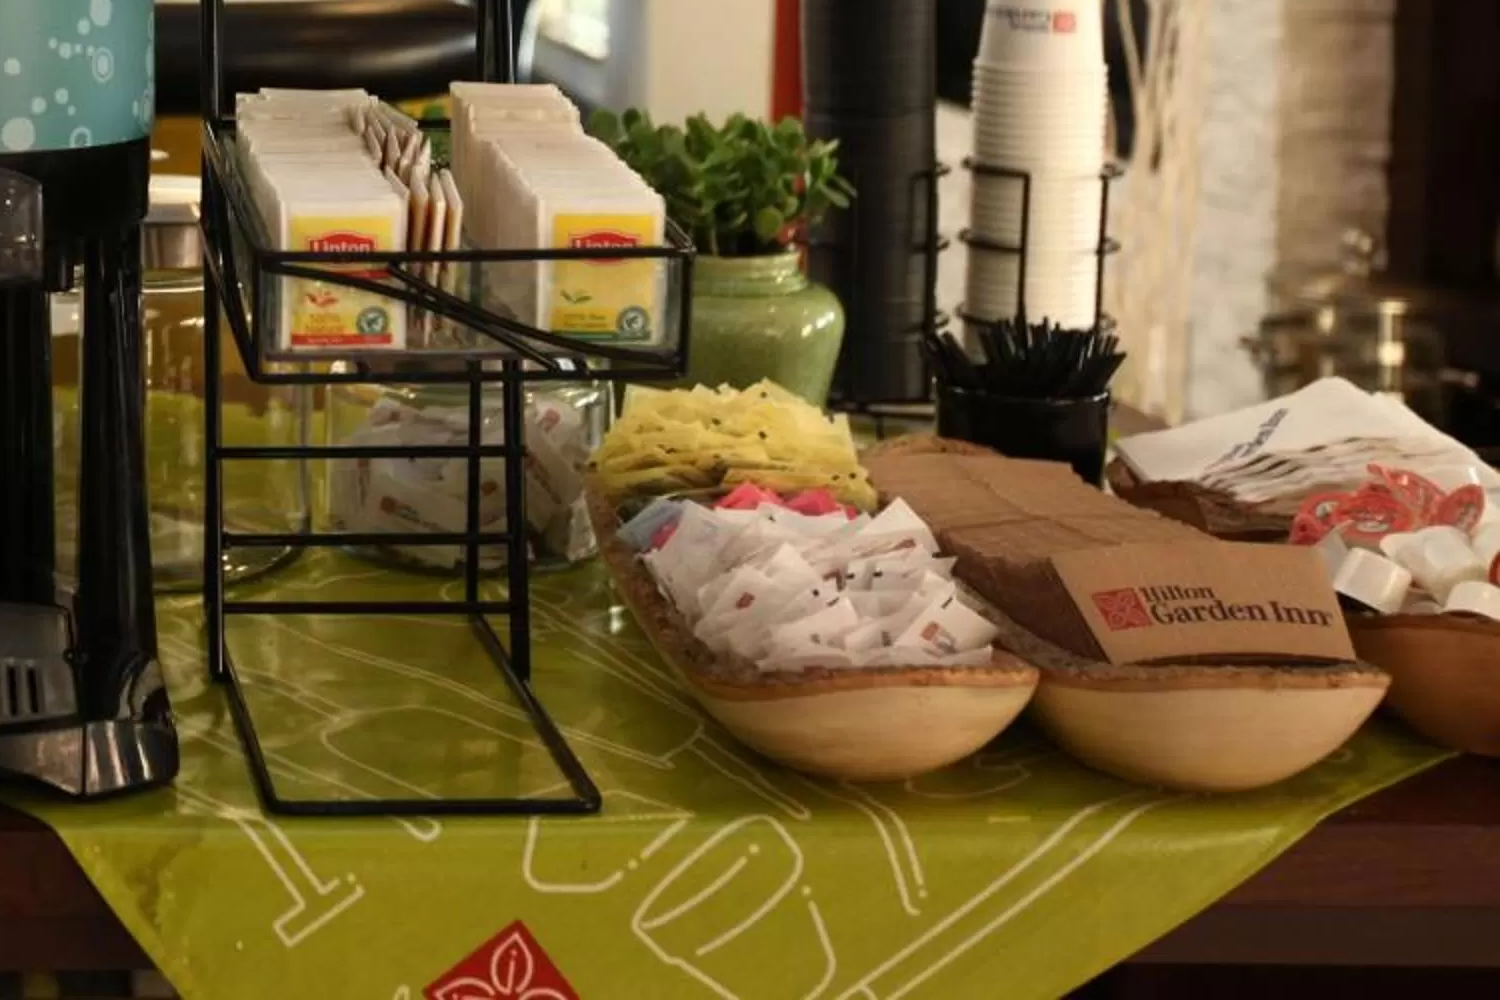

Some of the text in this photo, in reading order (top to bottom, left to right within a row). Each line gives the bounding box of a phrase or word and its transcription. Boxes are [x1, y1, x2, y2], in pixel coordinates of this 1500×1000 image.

[1140, 584, 1215, 602] Hilton
[1150, 600, 1329, 627] Garden Inn
